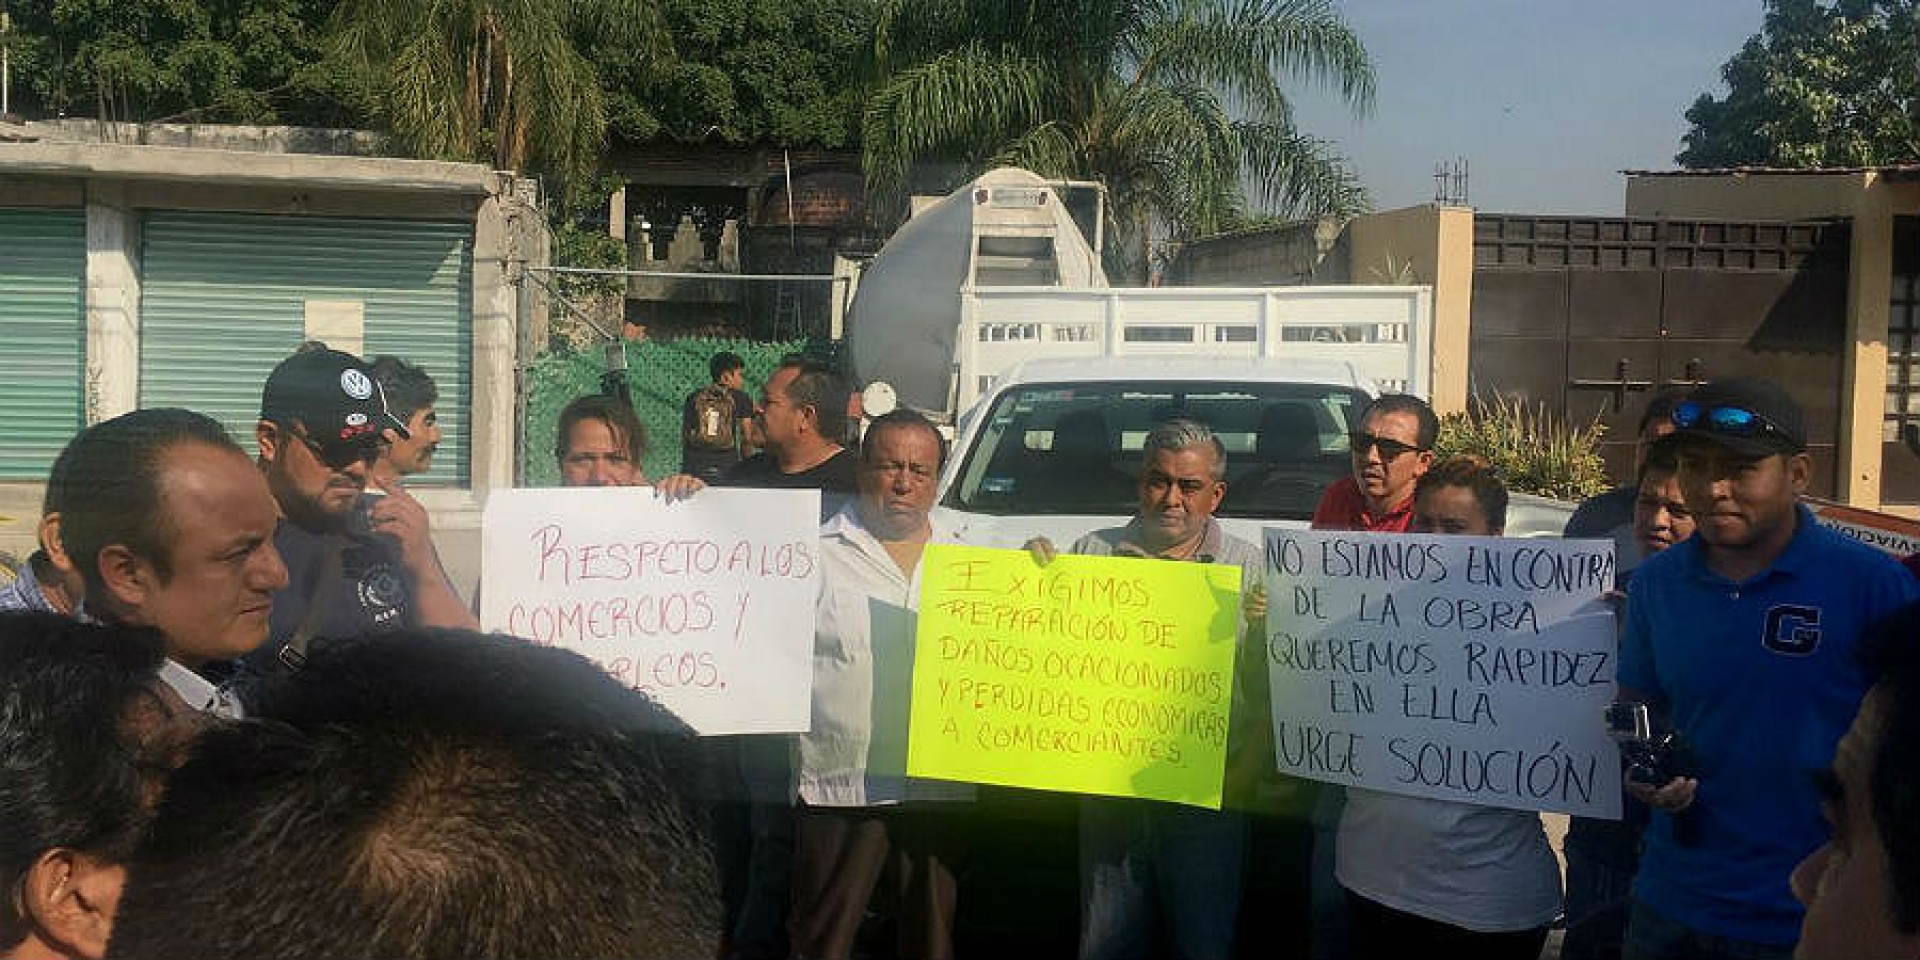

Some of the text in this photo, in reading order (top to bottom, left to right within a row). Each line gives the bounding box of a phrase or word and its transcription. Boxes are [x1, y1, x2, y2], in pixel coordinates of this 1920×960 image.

[530, 524, 815, 585] RESPETO A LOS
[1265, 535, 1616, 593] NO ESTAMOS EN CONTRA
[509, 591, 714, 645] COMERCIOS
[1139, 618, 1179, 650] DE
[1294, 585, 1539, 635] DE LA OBRA
[938, 635, 1222, 706] DAÑOS OCACIONADOS
[1268, 631, 1614, 688] QUEREMOS RAPIDEZ
[938, 678, 950, 708] Y
[958, 676, 1091, 725] PERDIDAS
[1330, 679, 1498, 727] EN ELLA
[942, 715, 959, 743] A
[1277, 721, 1597, 803] URGE SOLUCIÓN
